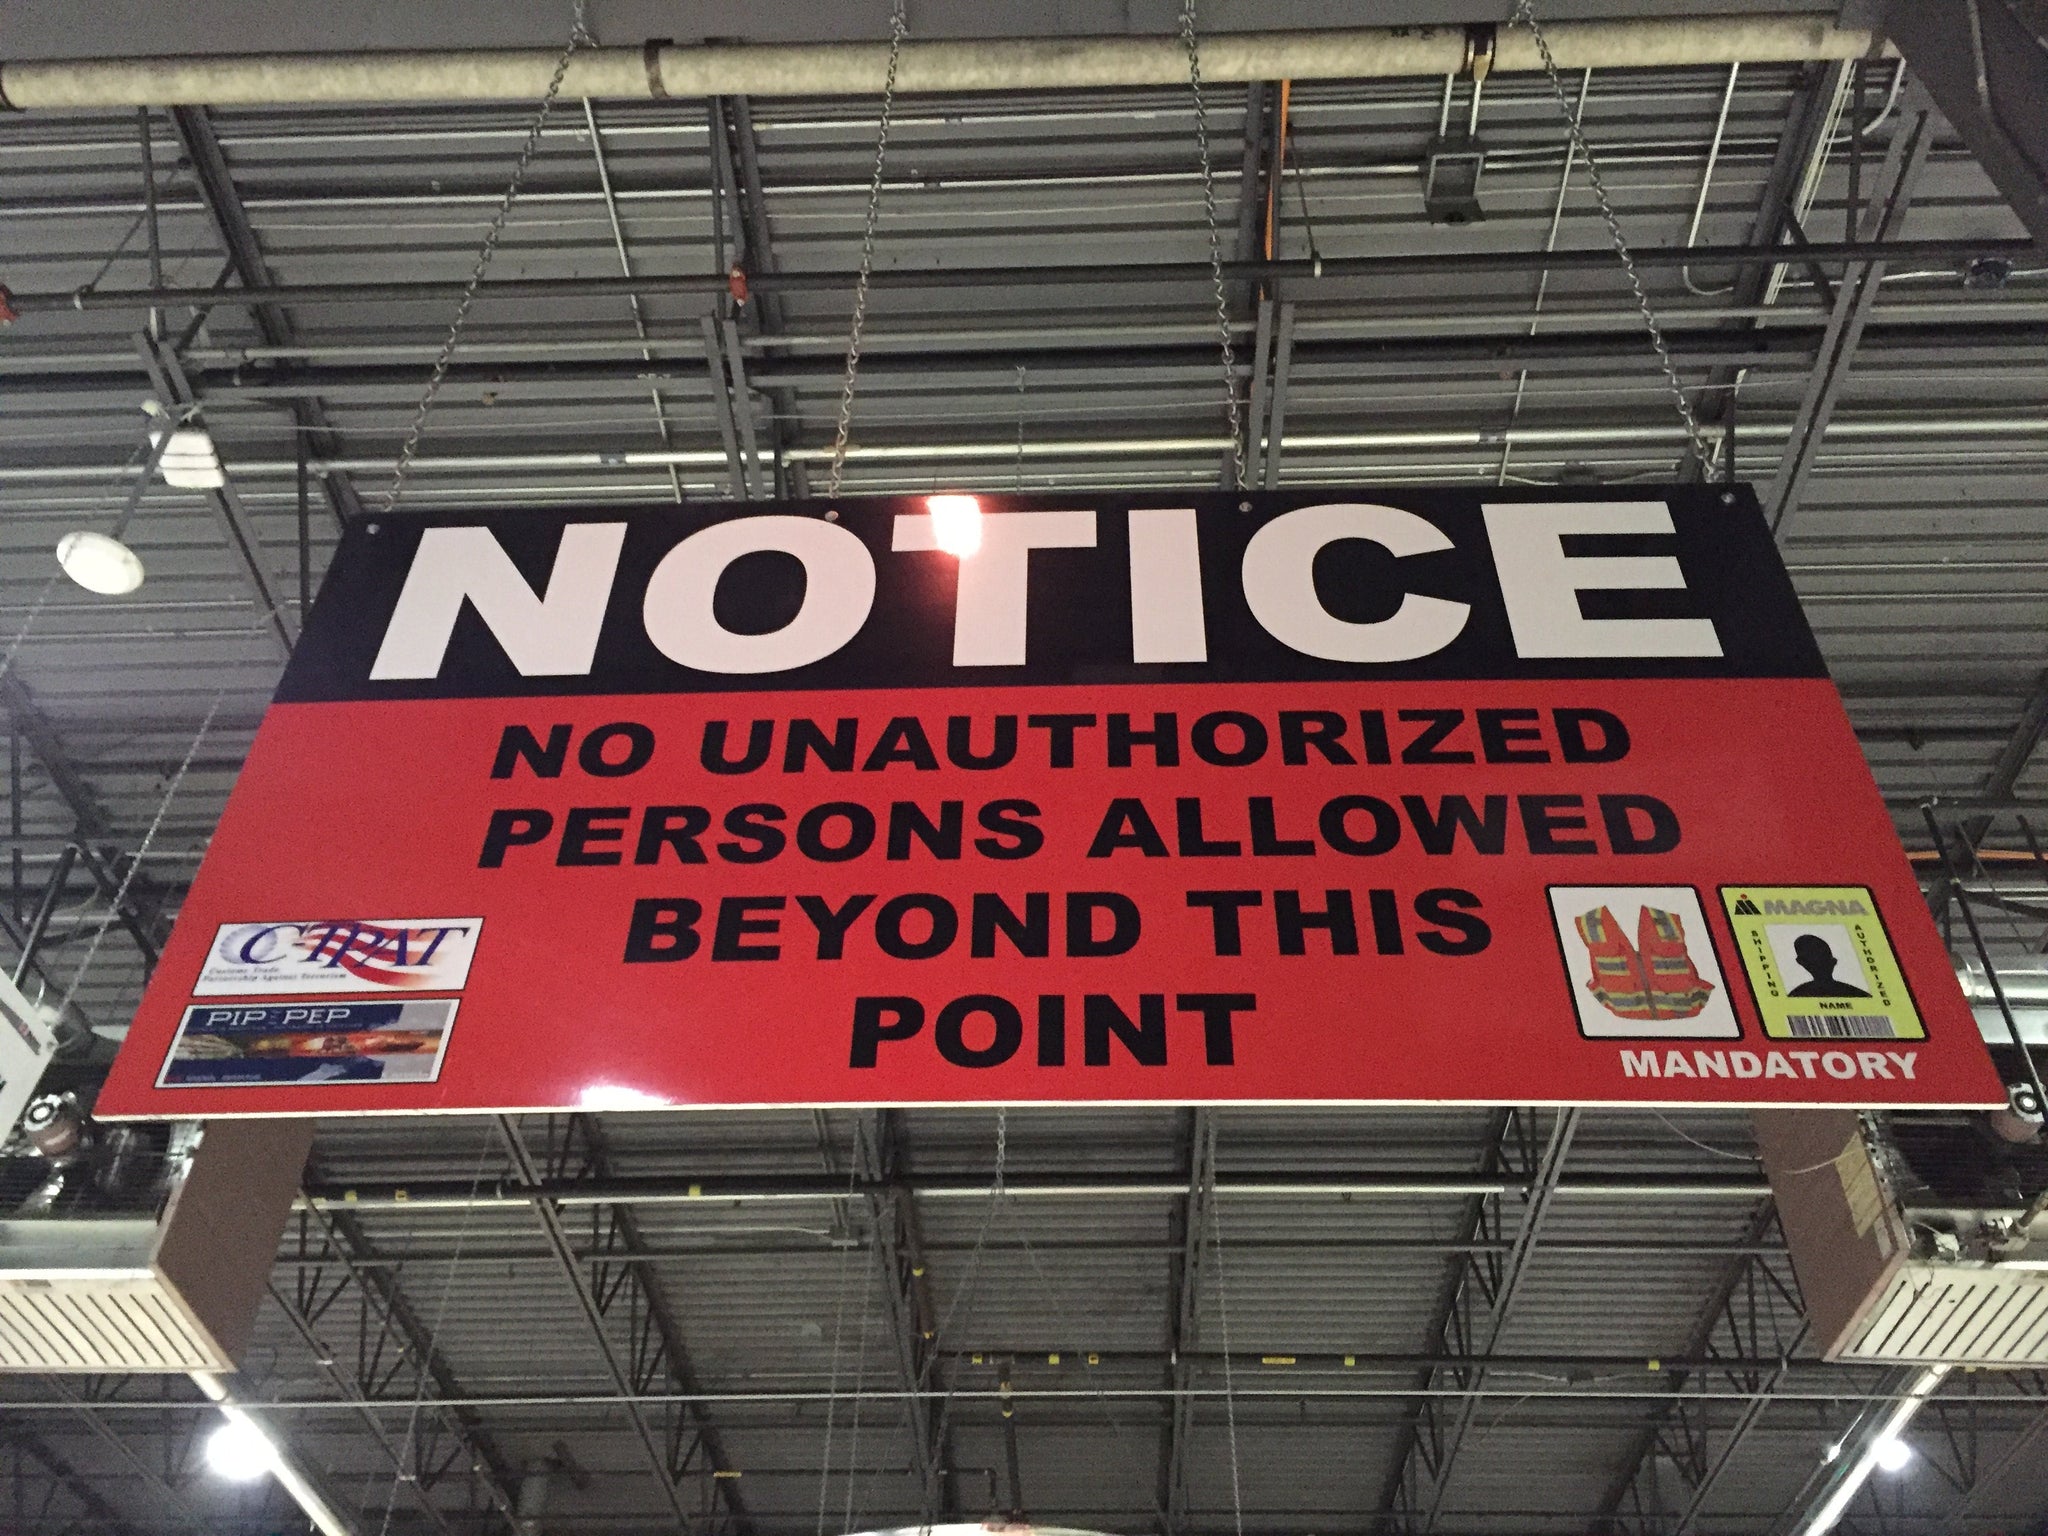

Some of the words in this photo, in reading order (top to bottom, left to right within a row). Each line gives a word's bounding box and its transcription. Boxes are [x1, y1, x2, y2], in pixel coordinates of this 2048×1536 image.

[368, 500, 1726, 683] NOTICE
[491, 724, 654, 780] NO
[701, 708, 1631, 775] UNAUTHORIZED
[479, 799, 1044, 868] PERSONS
[1087, 794, 1681, 859] ALLOWED
[624, 892, 1142, 964] BEYOND
[1186, 888, 1491, 956] THIS
[1763, 899, 1870, 916] MAGNA
[1751, 930, 1779, 998] SHIPPING
[1855, 924, 1891, 1007] AUTHORIZED
[207, 1010, 267, 1027] PIP
[282, 1008, 351, 1025] PEP
[850, 994, 1256, 1068] POINT
[1819, 1002, 1854, 1011] NAME
[1619, 1049, 1918, 1080] MANDATORY
